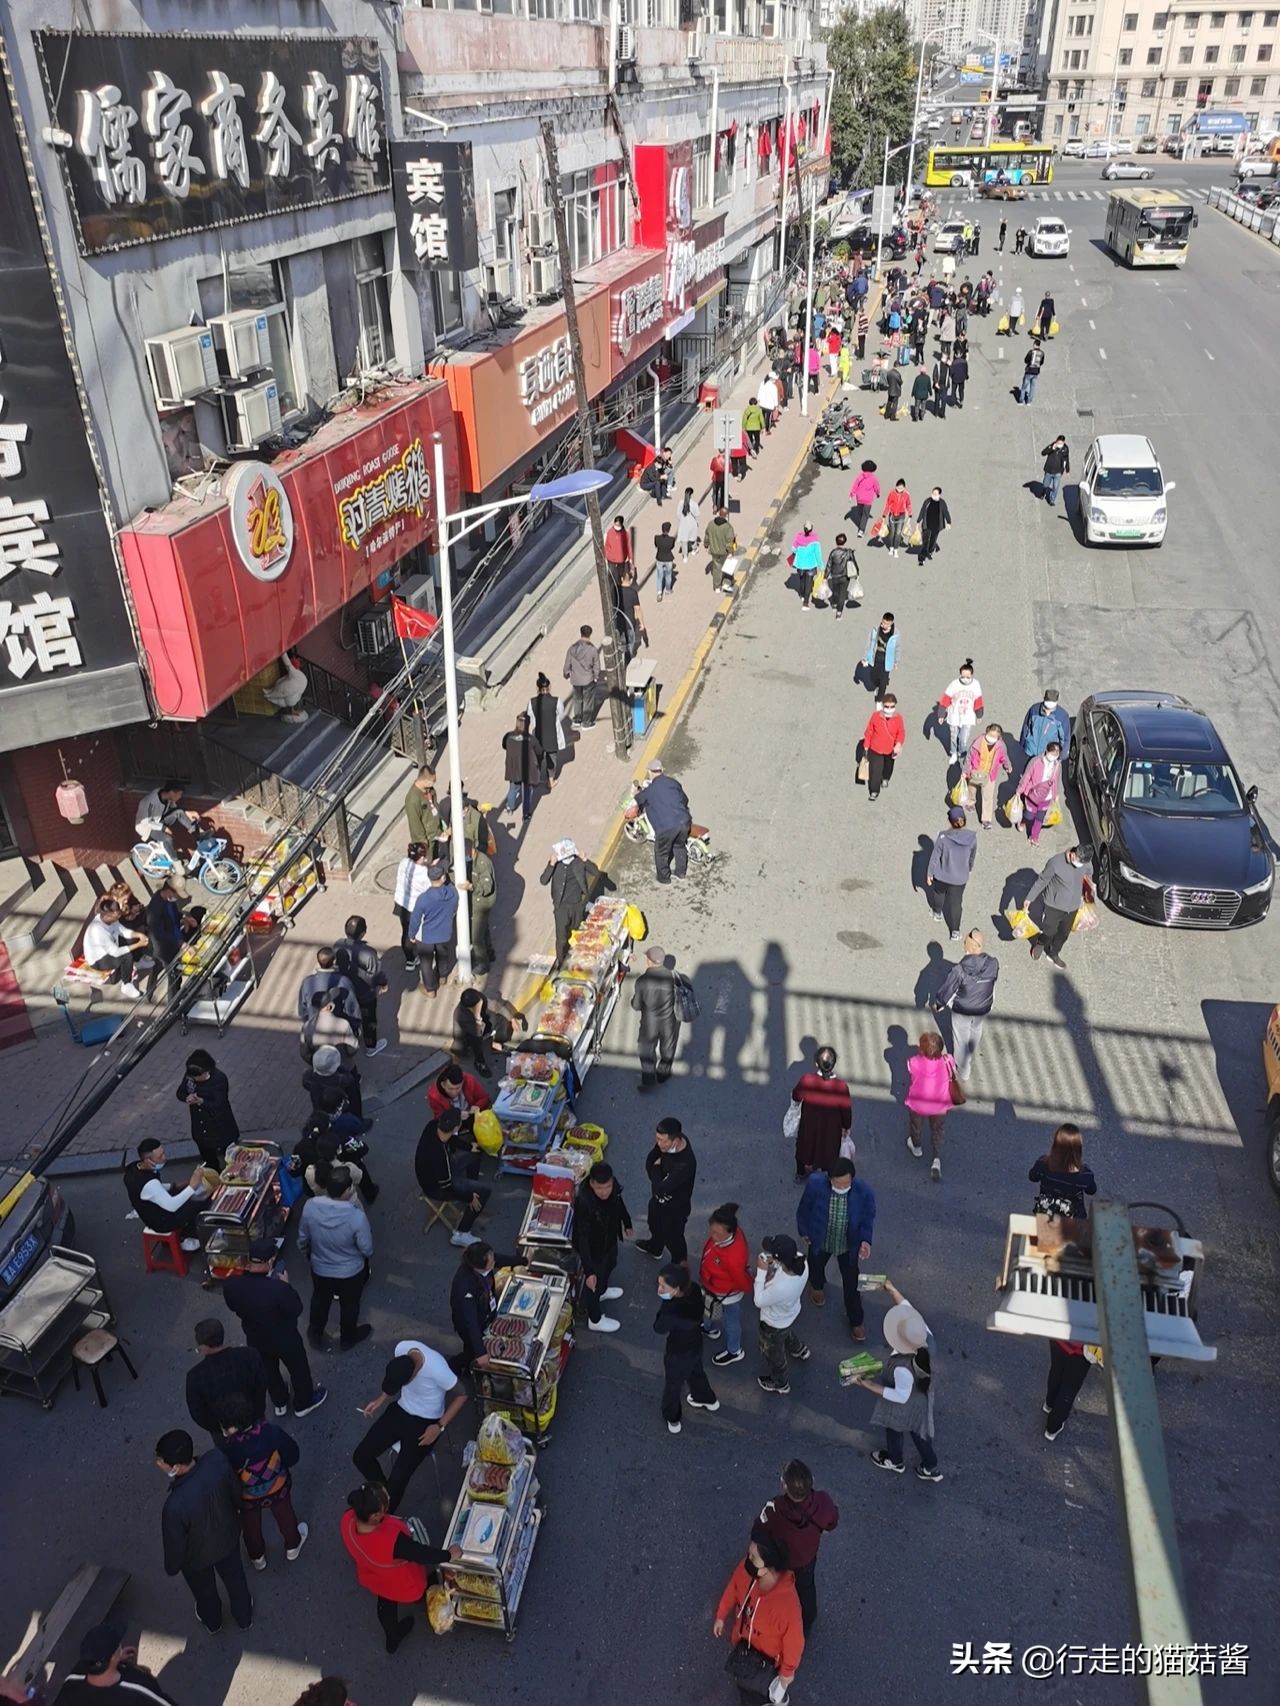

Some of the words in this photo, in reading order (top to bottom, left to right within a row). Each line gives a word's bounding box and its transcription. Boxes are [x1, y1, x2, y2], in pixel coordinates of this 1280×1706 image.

[406, 158, 449, 262] 宾馆
[340, 439, 430, 550] 对青烤鹅
[362, 456, 381, 477] ROAST
[381, 443, 400, 464] GOOSE
